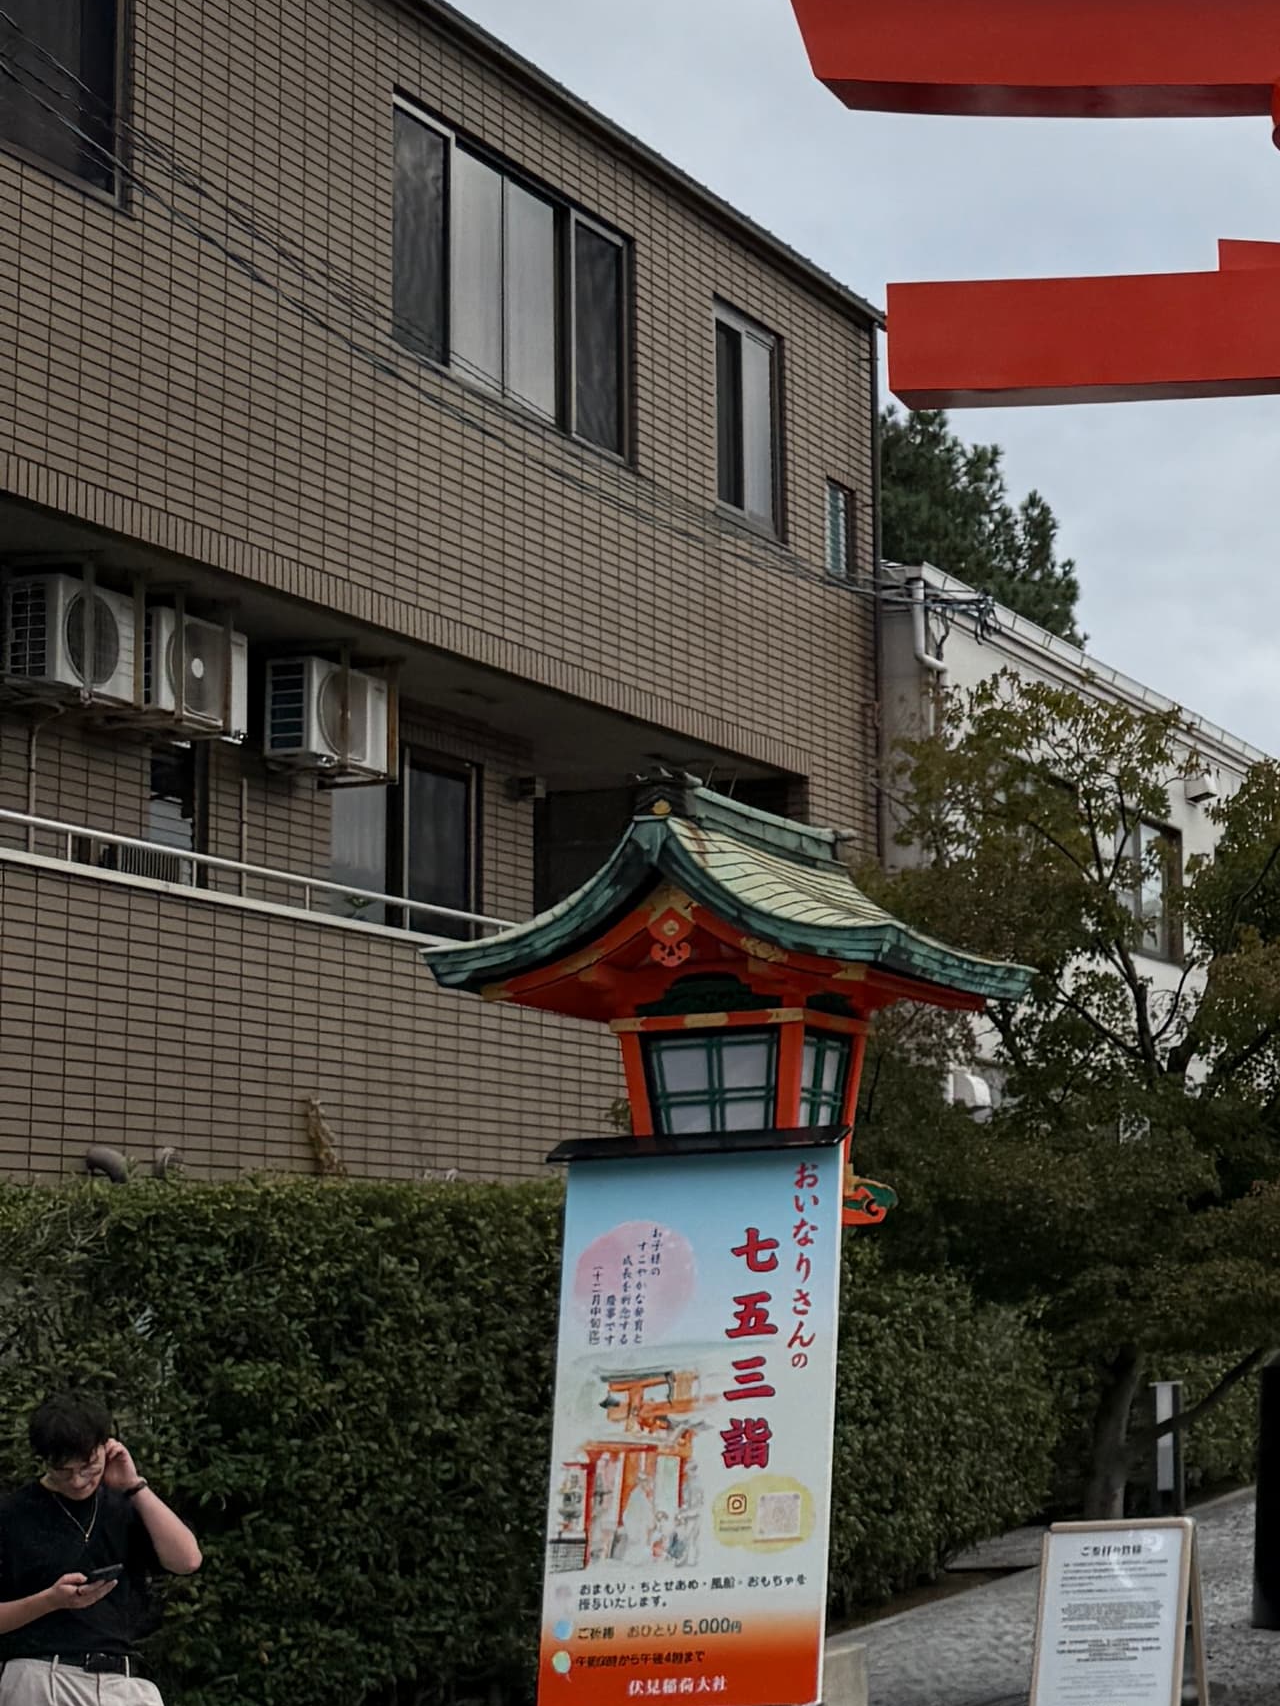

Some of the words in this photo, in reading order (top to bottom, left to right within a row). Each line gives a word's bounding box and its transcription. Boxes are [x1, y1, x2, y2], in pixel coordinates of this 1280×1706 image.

[786, 1161, 820, 1370] おいなりさんの
[720, 1227, 780, 1470] 七五三詣
[682, 1617, 743, 1636] 5,000円
[628, 1675, 728, 1697] 伏見稲荷大社
